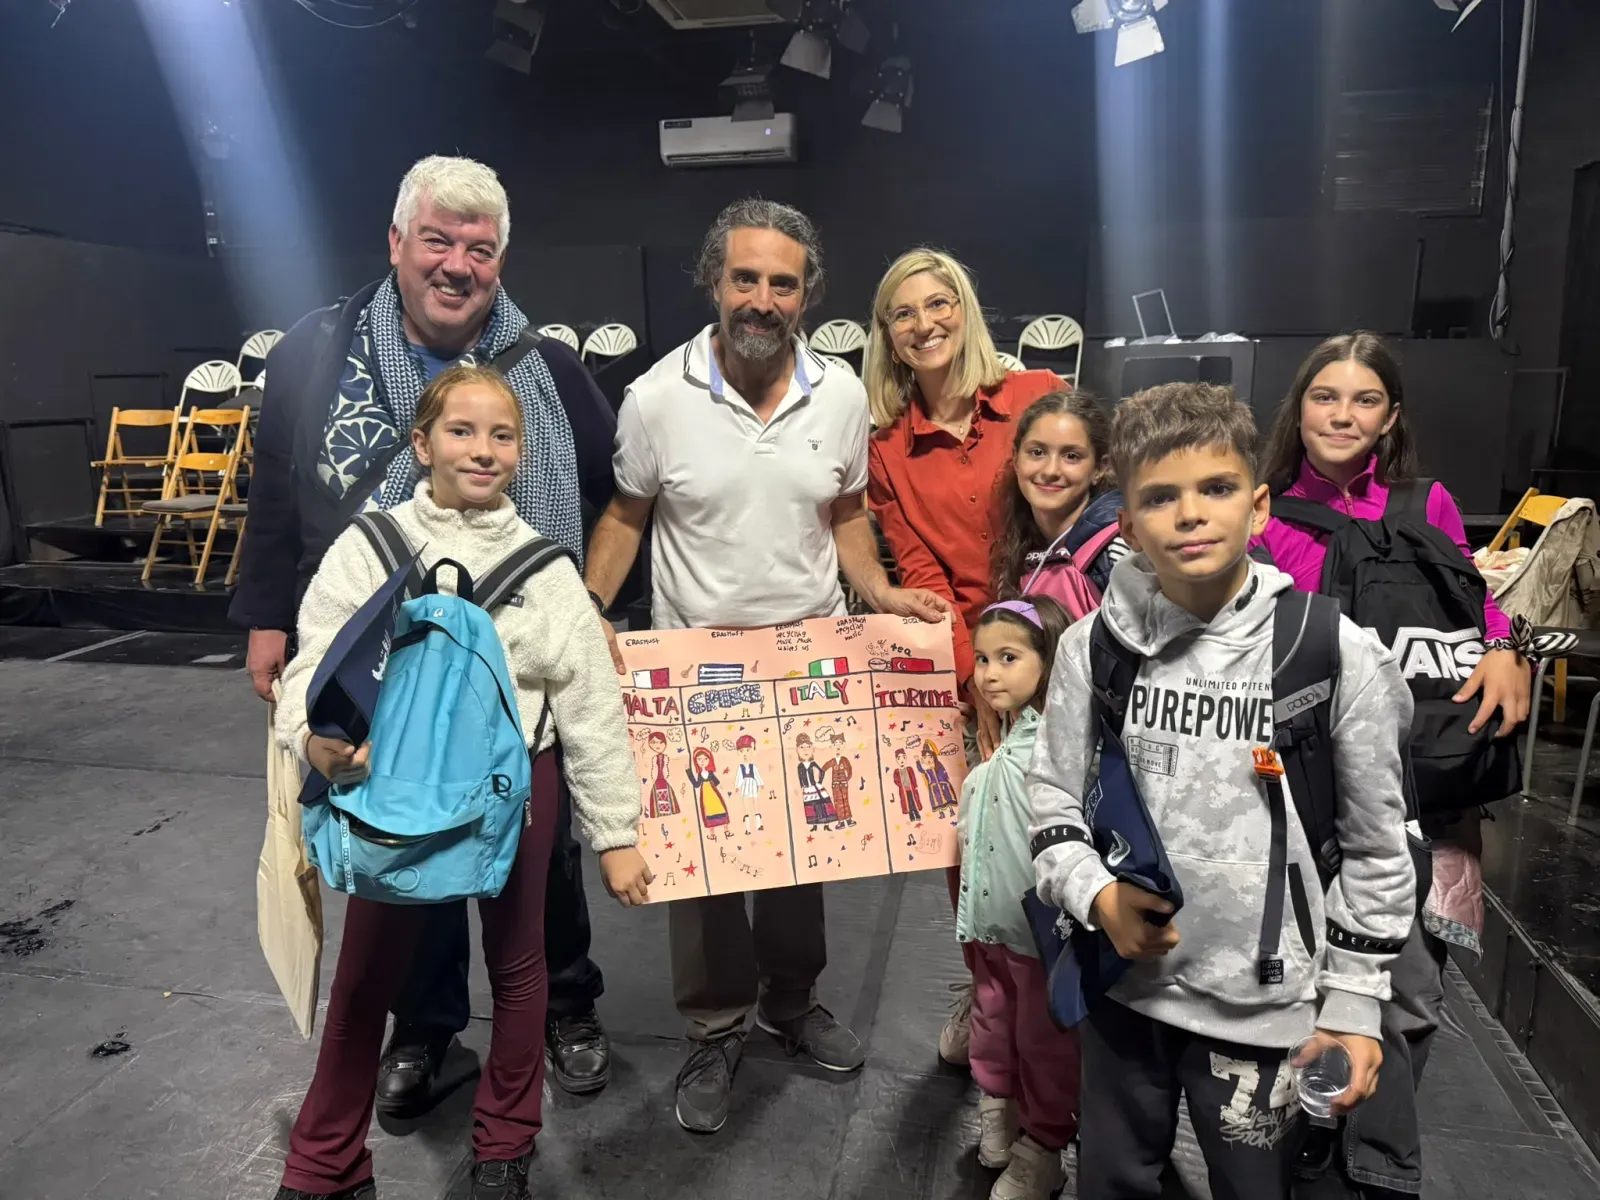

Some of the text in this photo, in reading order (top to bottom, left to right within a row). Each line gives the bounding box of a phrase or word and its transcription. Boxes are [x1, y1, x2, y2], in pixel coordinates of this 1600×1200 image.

[789, 678, 849, 705] ITALY
[1186, 677, 1237, 690] UNLIMITED
[1131, 684, 1273, 743] PUREPOWE
[1043, 828, 1067, 839] THE
